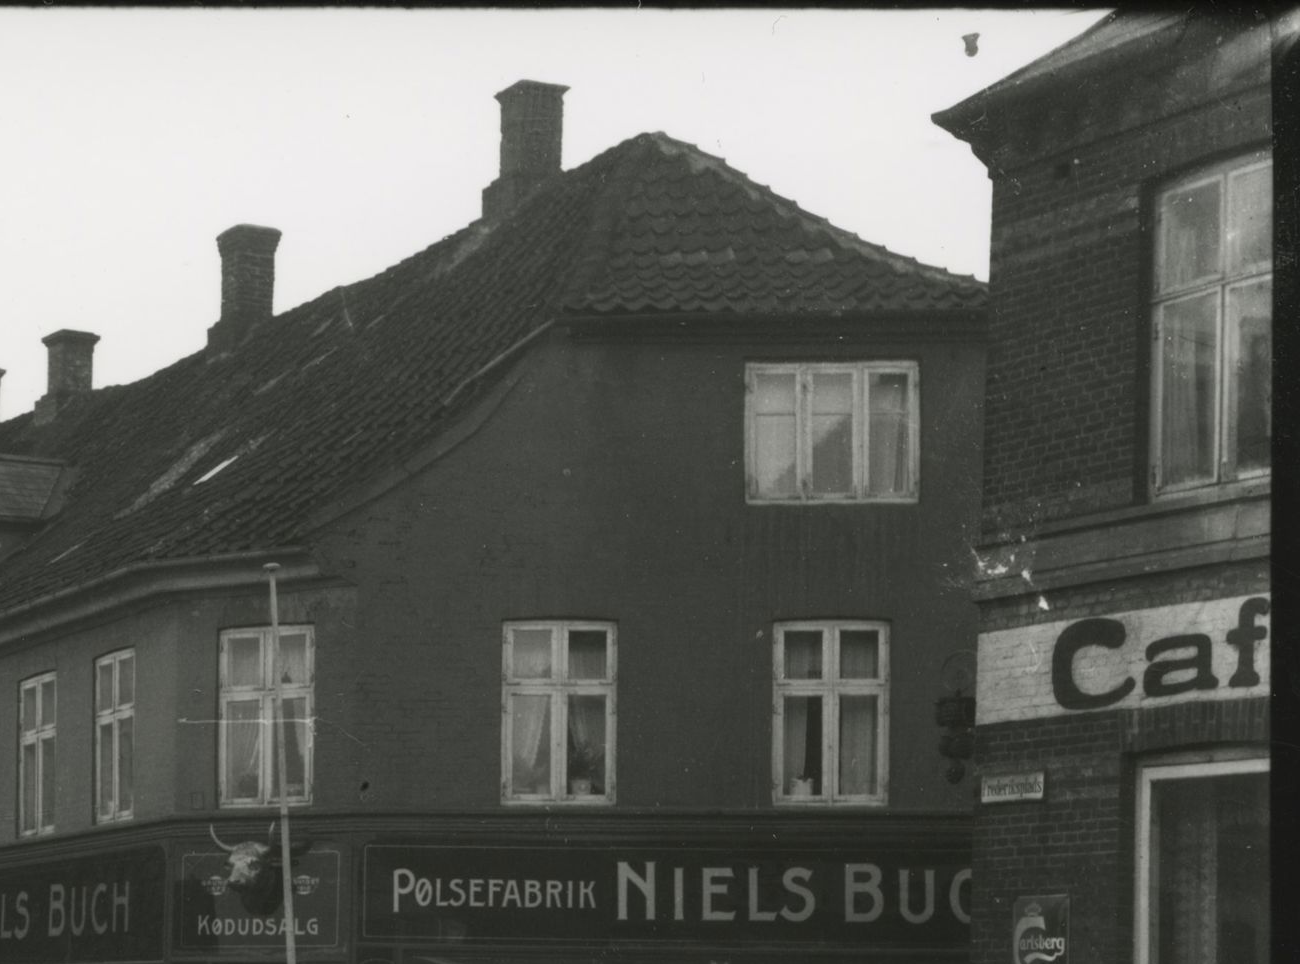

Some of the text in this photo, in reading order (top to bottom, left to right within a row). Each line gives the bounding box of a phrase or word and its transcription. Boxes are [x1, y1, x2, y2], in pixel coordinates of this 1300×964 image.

[1052, 597, 1270, 710] Caf
[47, 881, 130, 937] BUCH
[393, 868, 596, 913] PØLSEFABRIK
[617, 861, 816, 922] NIELS
